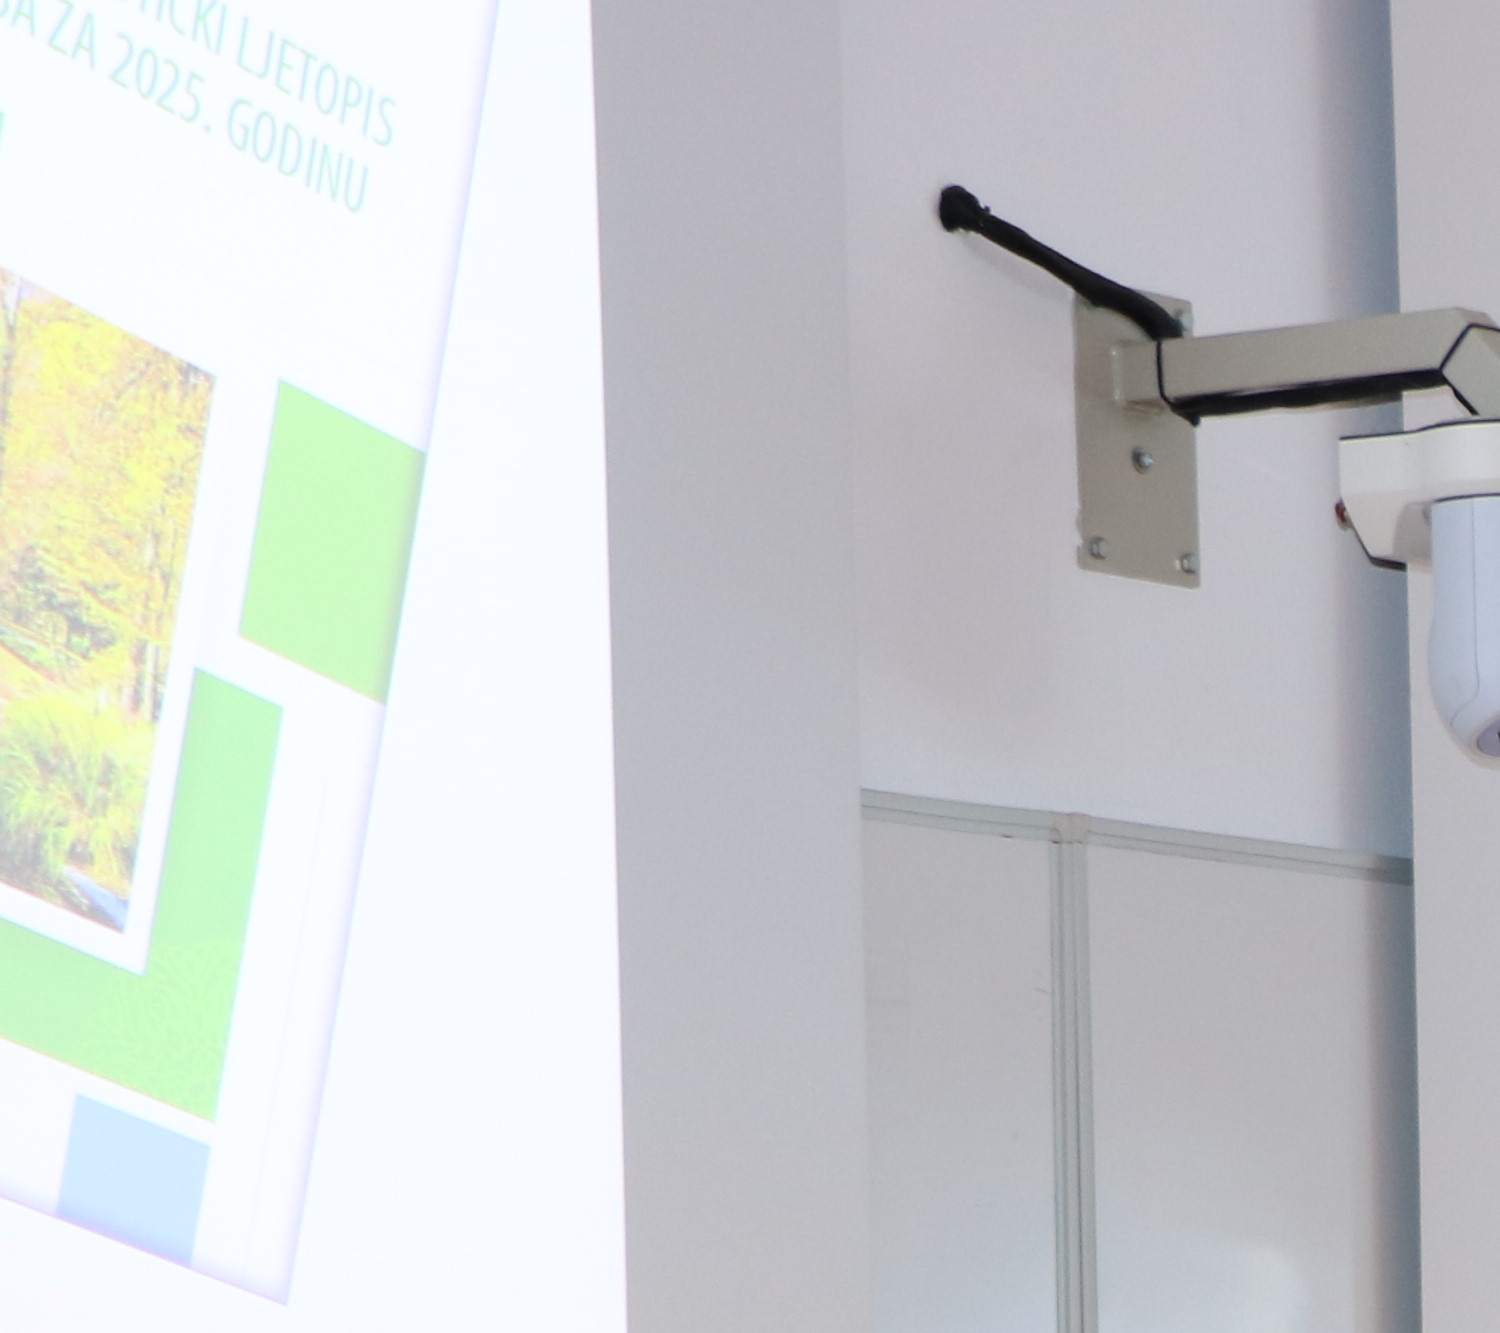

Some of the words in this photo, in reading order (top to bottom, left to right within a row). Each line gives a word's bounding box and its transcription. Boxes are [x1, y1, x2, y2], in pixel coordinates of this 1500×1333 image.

[48, 0, 97, 70] ZA
[108, 31, 212, 135] 2025.
[227, 97, 369, 214] GODINU
[236, 14, 398, 148] LJETOPIS
